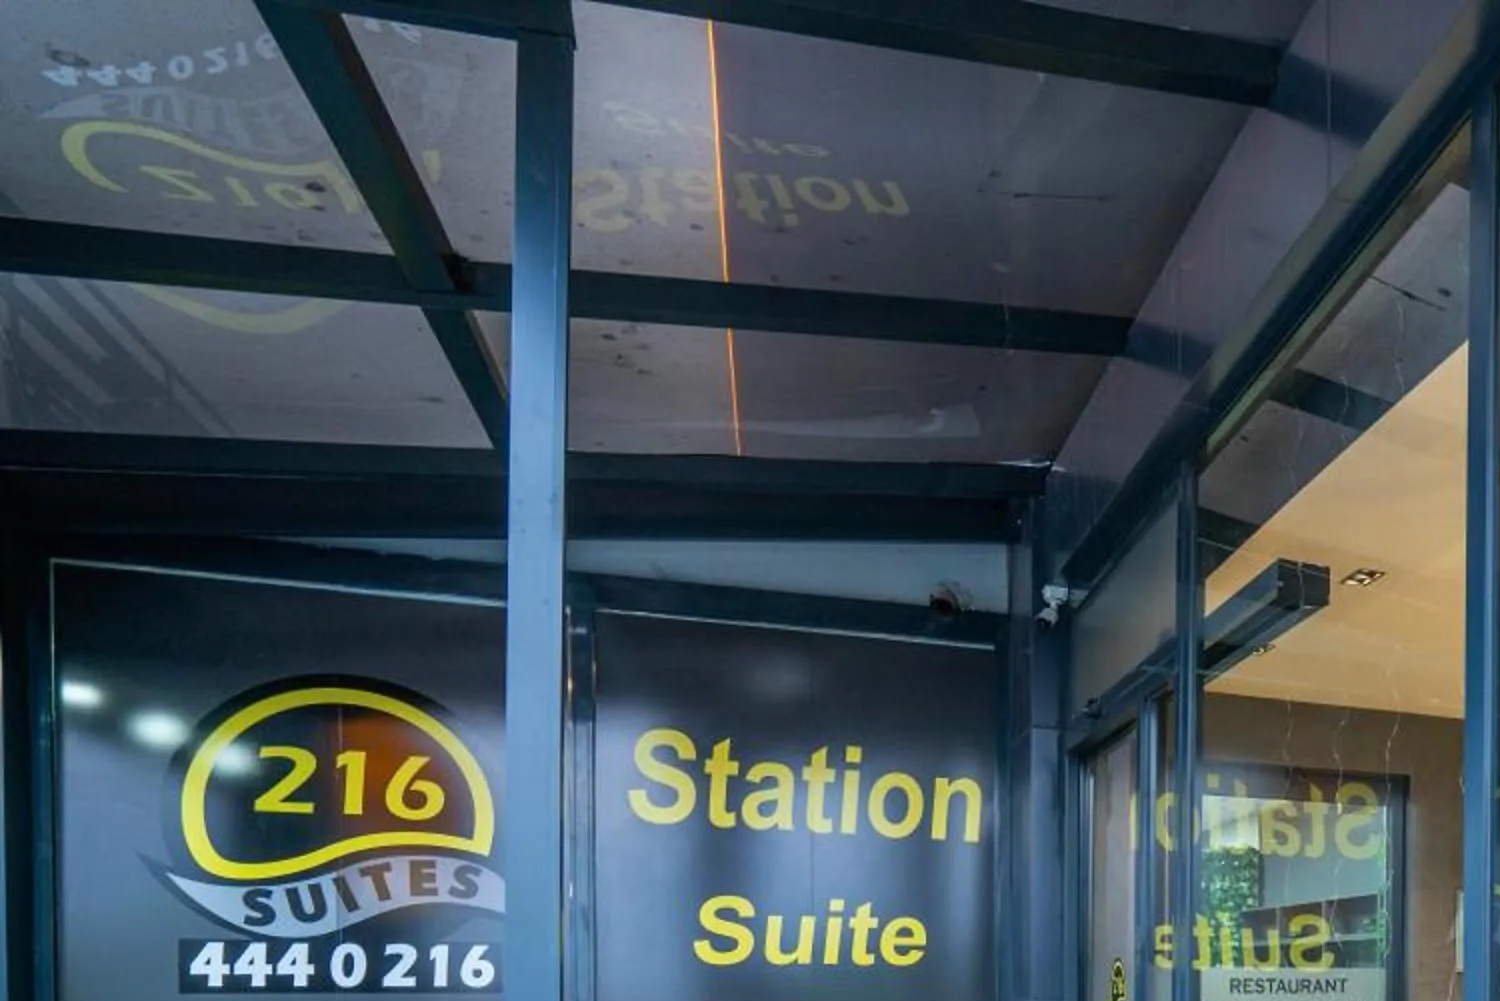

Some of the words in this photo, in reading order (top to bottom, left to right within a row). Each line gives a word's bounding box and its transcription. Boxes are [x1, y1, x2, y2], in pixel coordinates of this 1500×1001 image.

[253, 744, 446, 821] 216
[627, 727, 983, 844] Station
[242, 858, 483, 928] SUITES
[692, 894, 928, 967] Suite
[1229, 977, 1349, 995] RESTAURANT
